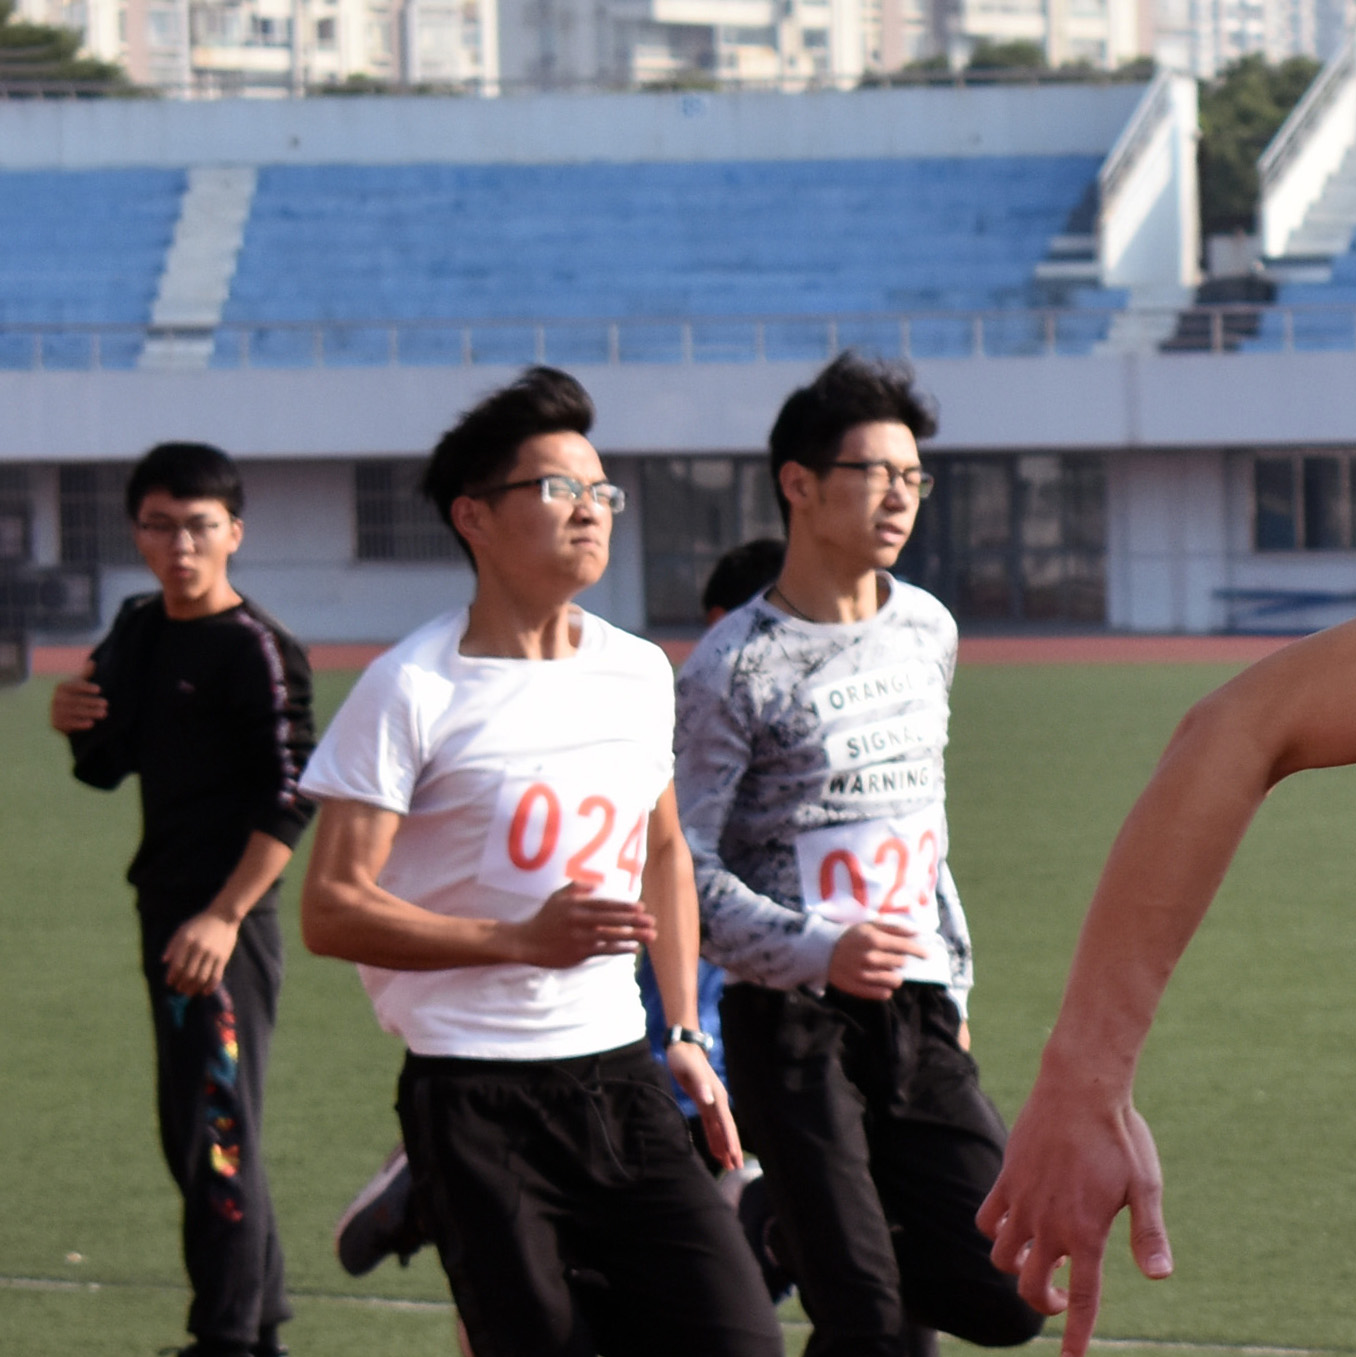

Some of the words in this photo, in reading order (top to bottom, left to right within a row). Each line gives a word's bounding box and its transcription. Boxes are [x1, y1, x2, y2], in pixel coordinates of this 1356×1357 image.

[829, 766, 929, 795] WARNING
[508, 782, 647, 892] 024
[819, 829, 938, 914] 023
